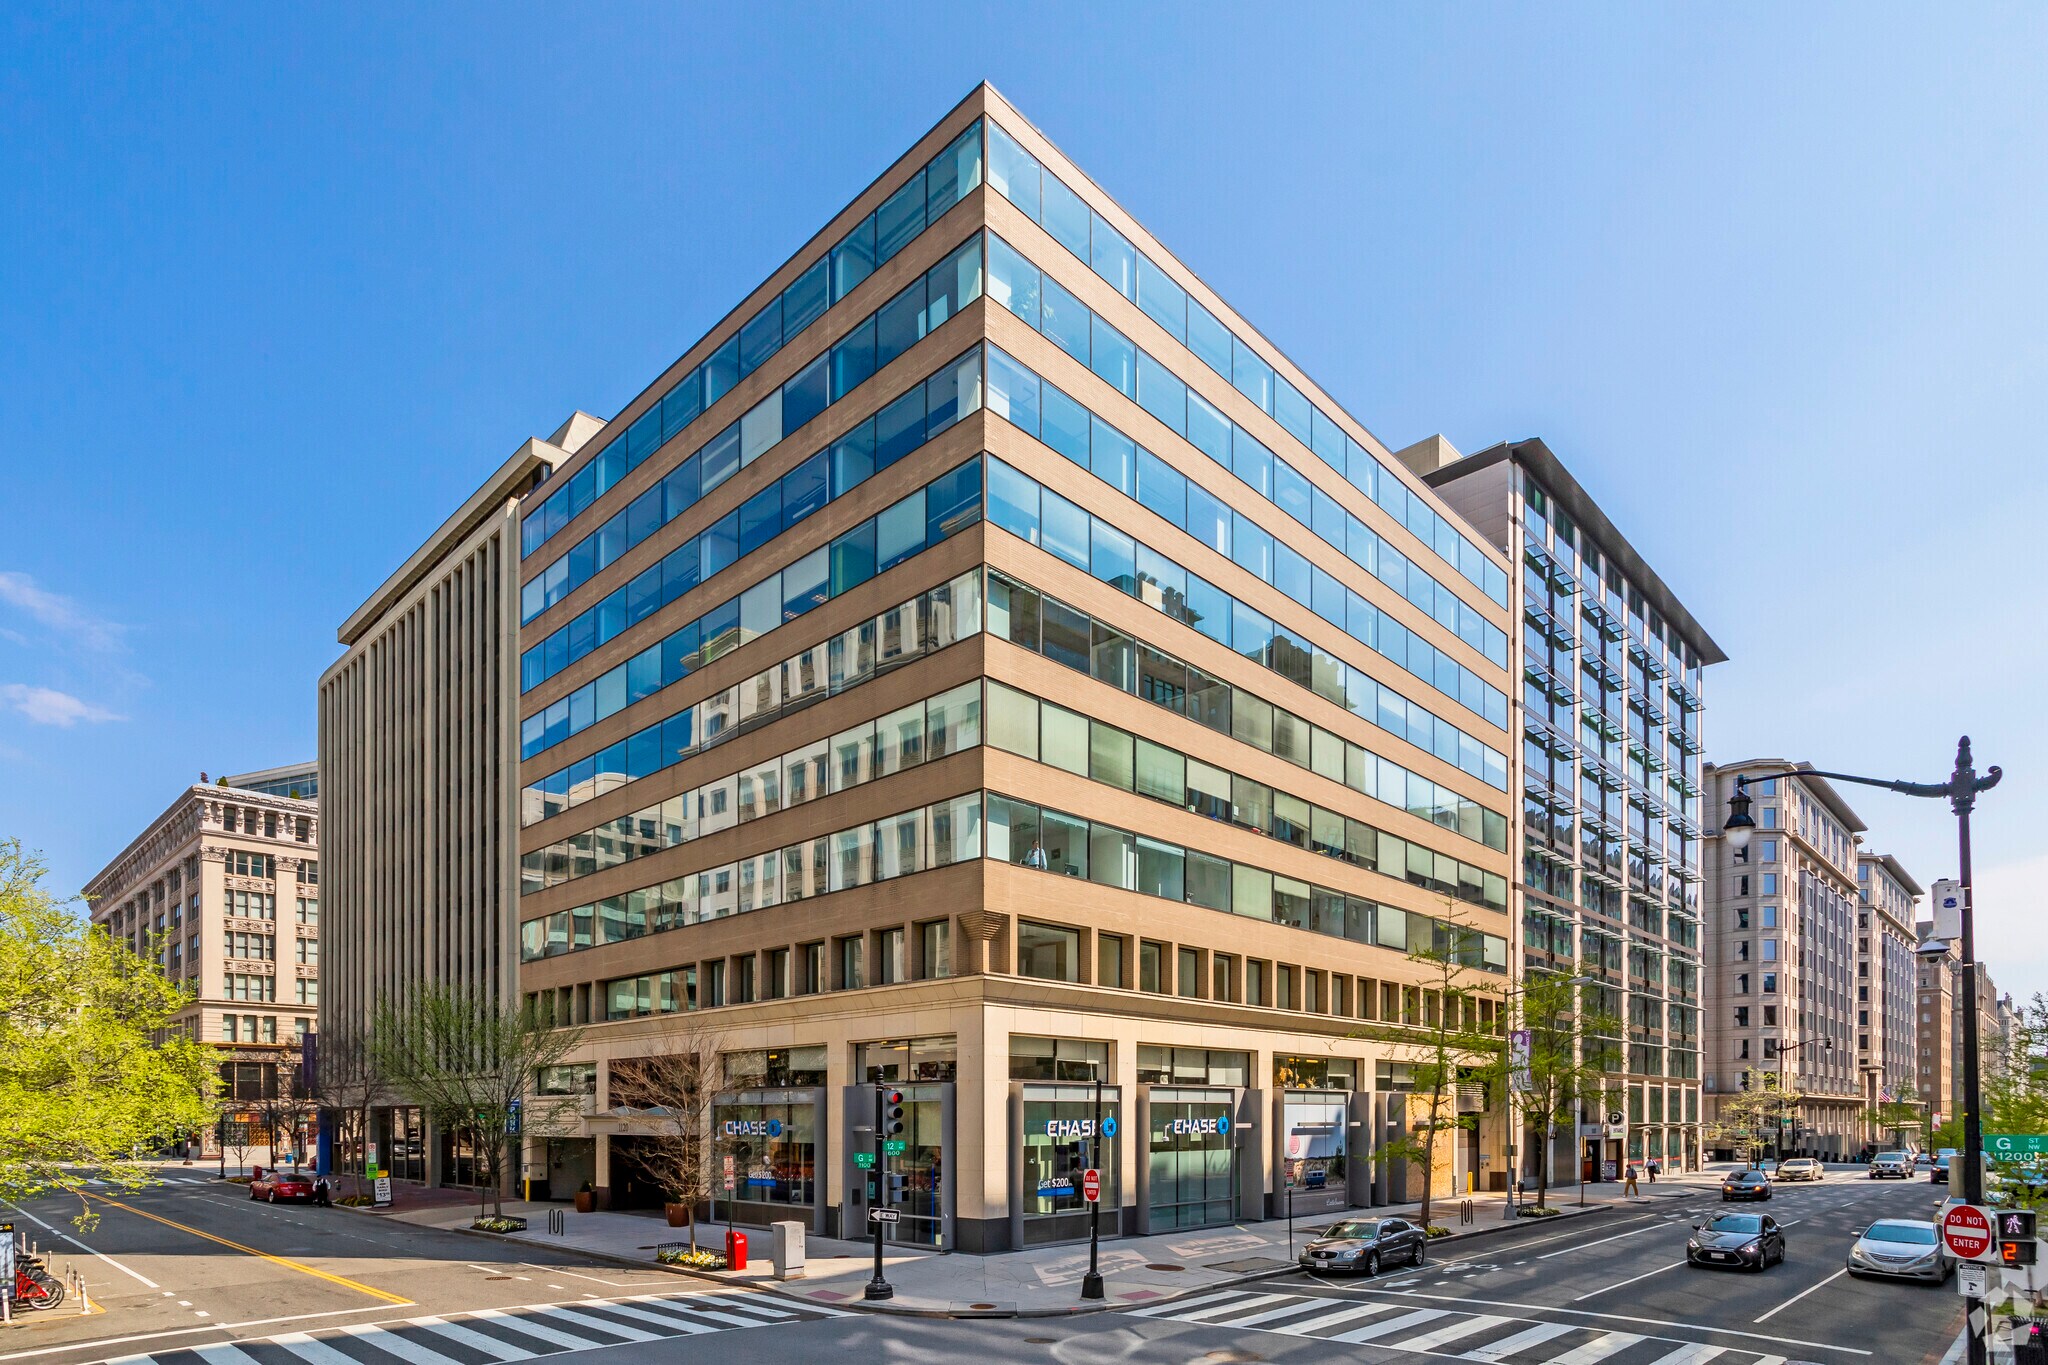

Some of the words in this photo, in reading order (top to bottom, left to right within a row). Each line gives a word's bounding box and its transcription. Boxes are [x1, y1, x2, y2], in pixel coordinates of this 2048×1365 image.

[1611, 1113, 1620, 1123] P
[618, 1123, 629, 1132] 1120
[726, 1120, 768, 1135] CHASE
[1173, 1118, 1217, 1135] CHASE
[886, 1142, 895, 1150] 12
[1996, 1137, 2011, 1150] G
[857, 1154, 864, 1162] G
[1998, 1152, 2033, 1161] 1200
[1038, 1179, 1051, 1189] Get
[1051, 1177, 1069, 1188] $200
[1949, 1214, 1962, 1224] DO
[1966, 1216, 1983, 1226] NOT
[1953, 1237, 1980, 1249] ENTER
[2003, 1243, 2017, 1260] 2
